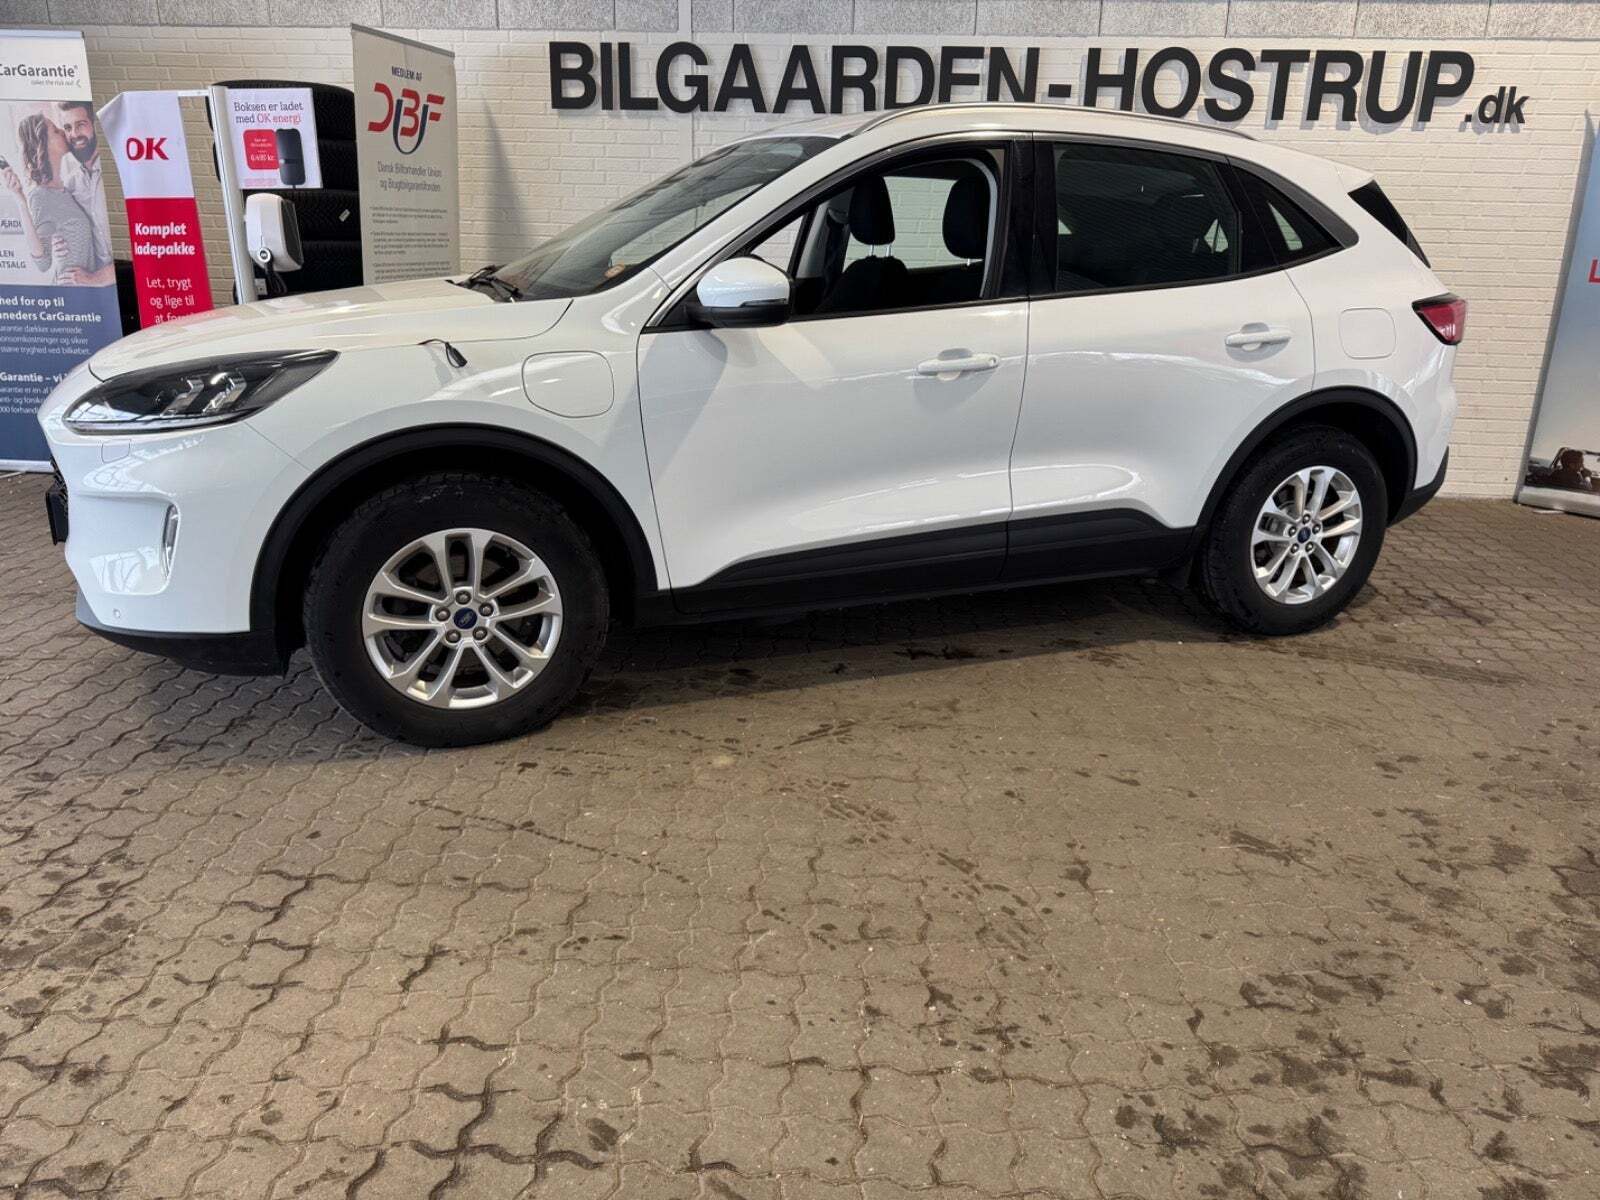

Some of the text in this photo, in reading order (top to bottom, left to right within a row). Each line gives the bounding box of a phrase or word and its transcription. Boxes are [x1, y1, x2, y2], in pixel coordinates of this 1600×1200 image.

[234, 102, 266, 112] Boksen
[280, 101, 304, 111] ladet
[235, 113, 301, 125] med OK energi
[126, 137, 169, 160] OK
[134, 222, 186, 238] Komplet
[134, 242, 195, 258] ladepakke
[146, 277, 192, 291] Let, trygt
[20, 296, 35, 306] for
[38, 299, 51, 309] op
[53, 297, 65, 307] til
[150, 295, 195, 309] og lige til
[40, 311, 102, 322] CarGarantie
